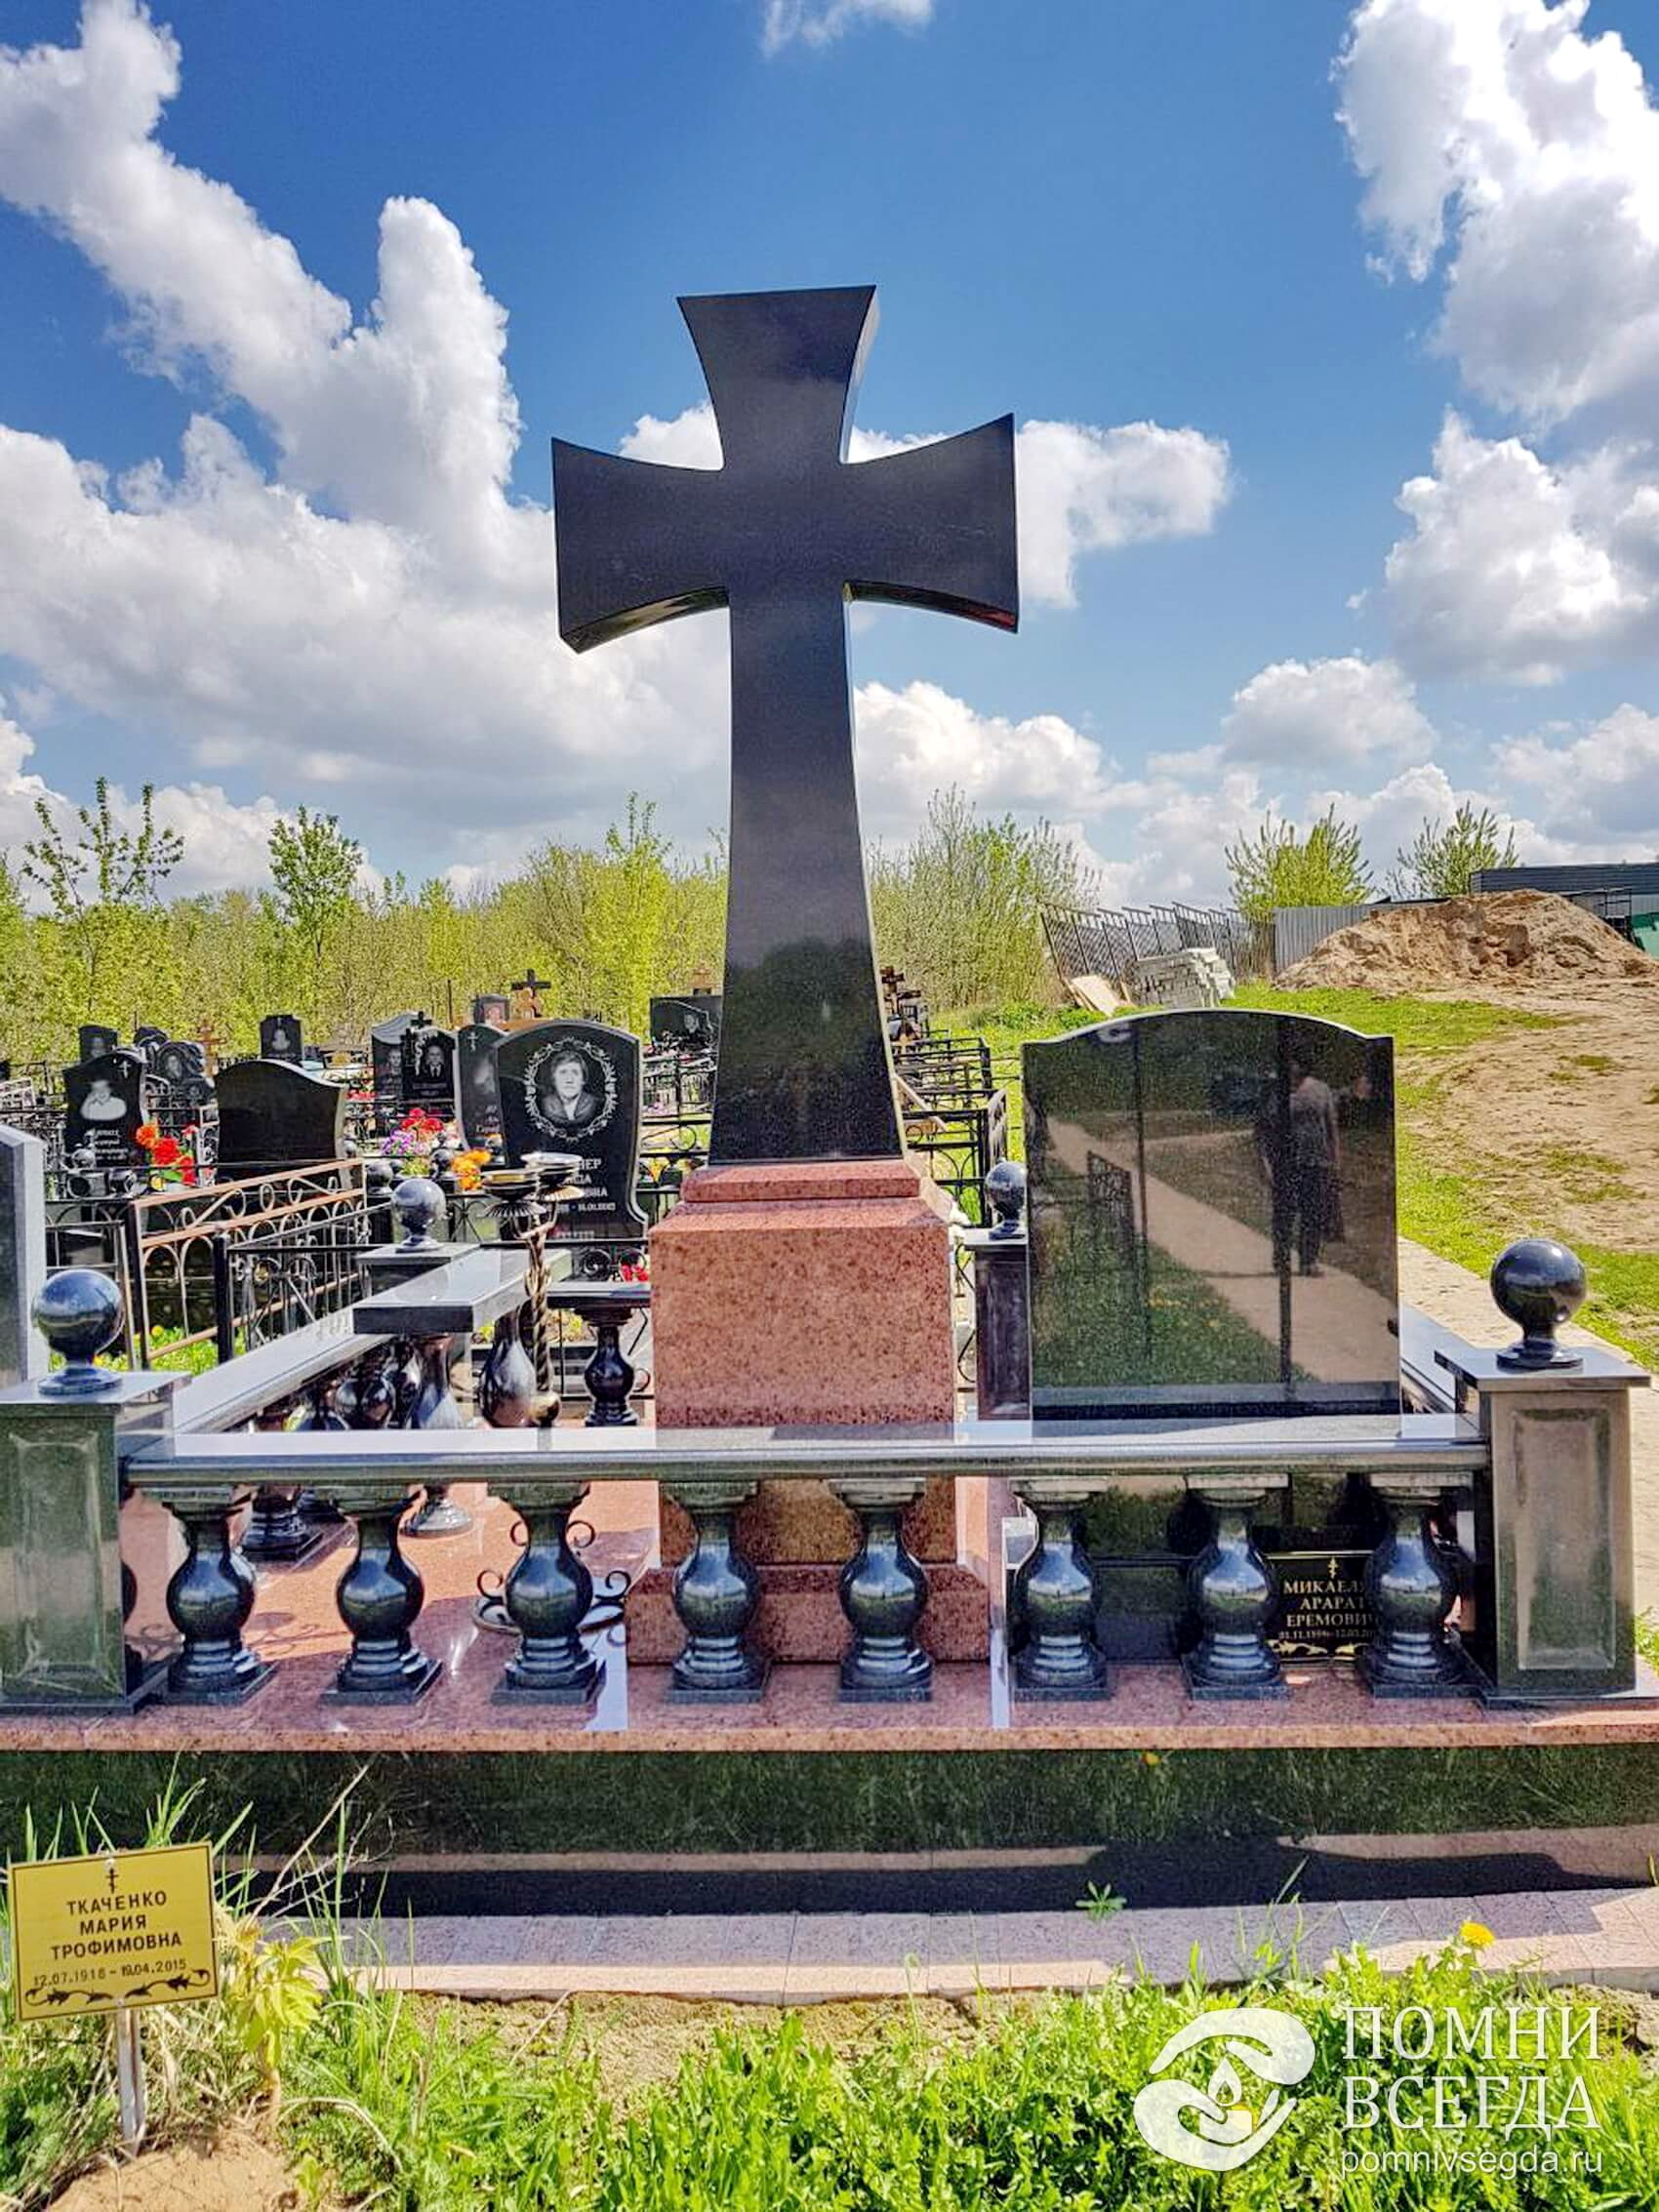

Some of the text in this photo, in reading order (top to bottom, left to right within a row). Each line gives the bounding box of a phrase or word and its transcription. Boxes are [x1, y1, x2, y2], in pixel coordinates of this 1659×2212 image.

[1283, 1579, 1365, 1593] МИКАЕЛ
[67, 1890, 167, 1915] ТКАЧЕНКО
[80, 1914, 146, 1936] МАРИЯ
[51, 1932, 182, 1960] ТРОФИМОВНА
